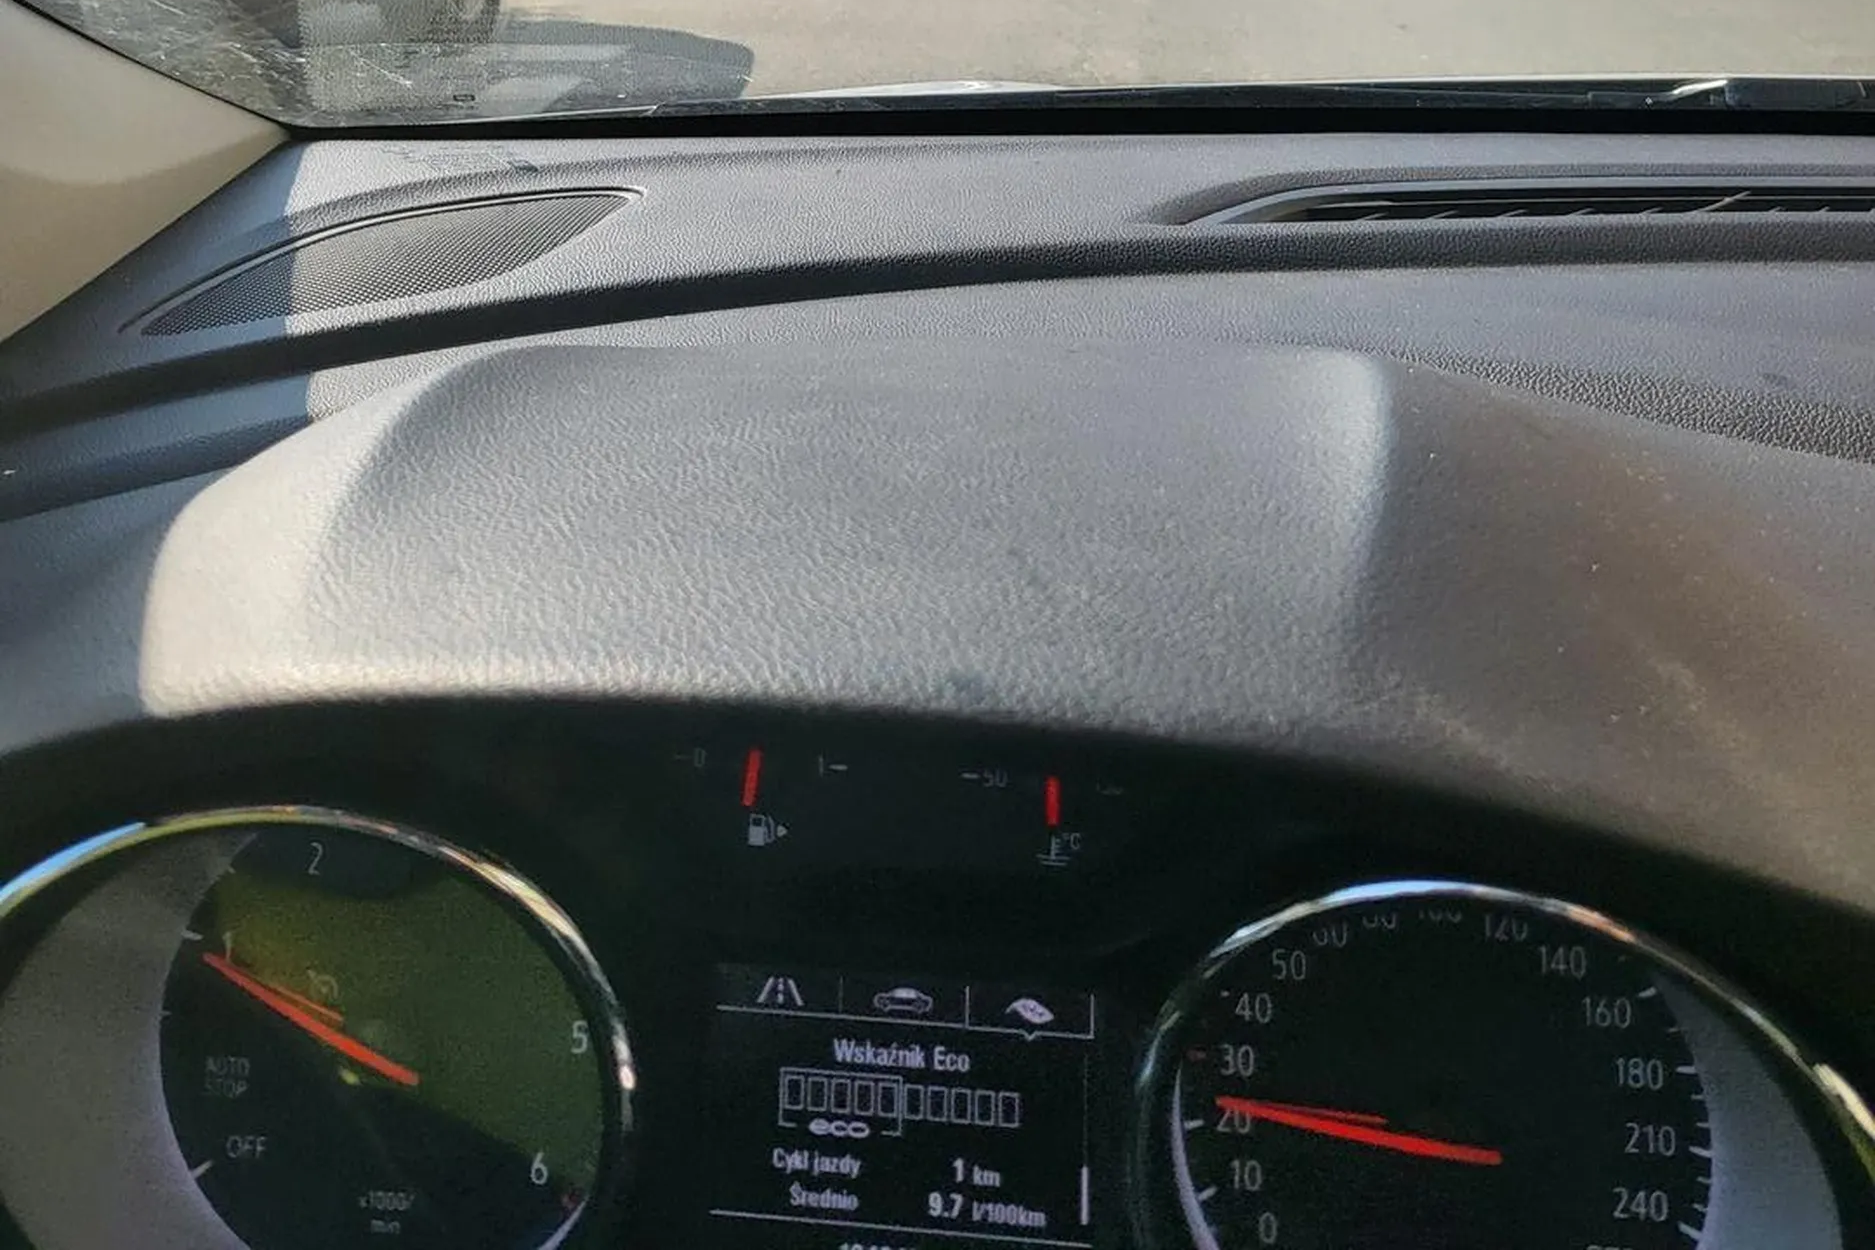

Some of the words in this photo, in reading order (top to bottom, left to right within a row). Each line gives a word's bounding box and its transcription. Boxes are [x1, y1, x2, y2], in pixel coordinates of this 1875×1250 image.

[310, 841, 324, 876] 2
[1271, 948, 1307, 981] 50
[1538, 946, 1587, 979] 140
[1235, 992, 1272, 1024] 40
[1582, 997, 1632, 1029] 160
[571, 1019, 588, 1054] 5
[205, 1055, 251, 1077] AUTO
[833, 1037, 925, 1068] Wskaźnik
[933, 1045, 970, 1072] Eco
[1219, 1043, 1255, 1077] 30
[1615, 1057, 1664, 1091] 180
[808, 1117, 870, 1139] eco
[1216, 1106, 1250, 1134] 20
[225, 1135, 268, 1159] OFF
[1624, 1122, 1676, 1157] 210
[531, 1151, 548, 1185] 6
[772, 1147, 809, 1175] Cykl
[812, 1149, 861, 1179] jazdy
[952, 1157, 964, 1183] 1
[973, 1164, 1001, 1187] km
[1230, 1159, 1263, 1192] 10
[789, 1180, 859, 1211] Średnio
[927, 1191, 963, 1219] 9.7
[972, 1199, 1047, 1228] l/100km
[1612, 1187, 1669, 1222] 240
[1258, 1211, 1278, 1244] 0
